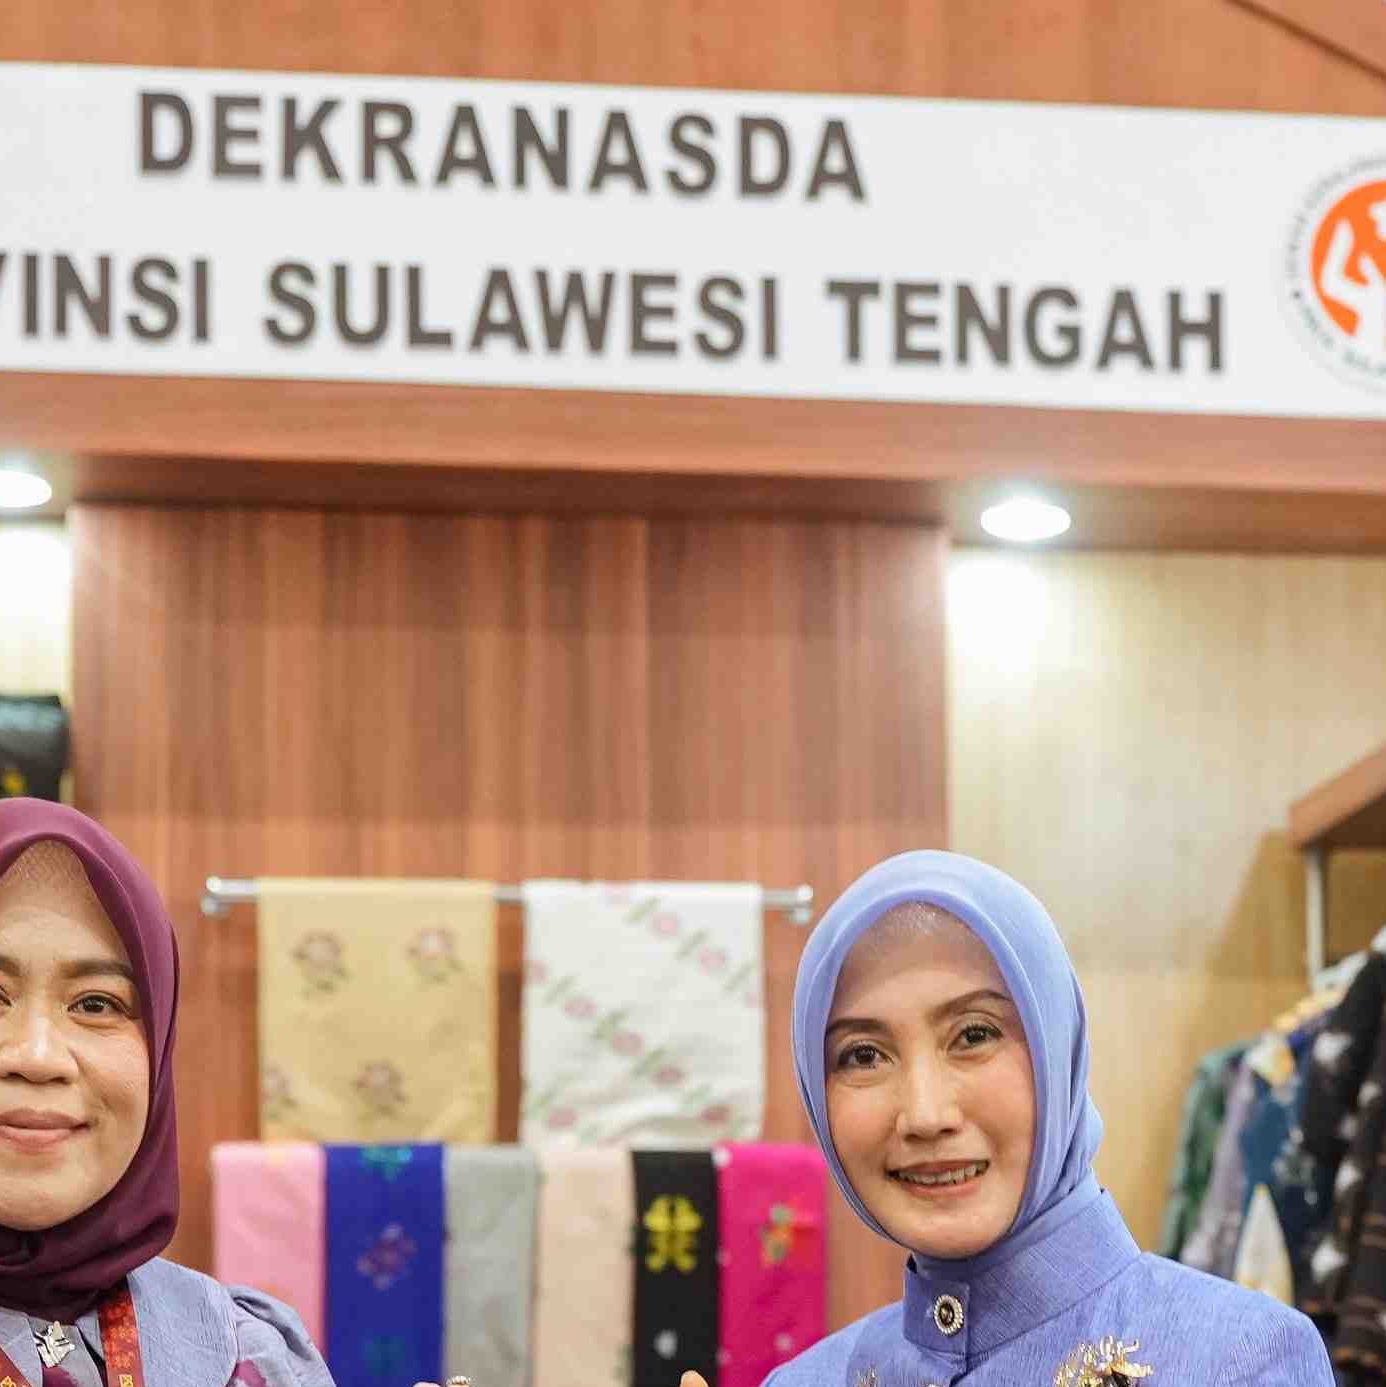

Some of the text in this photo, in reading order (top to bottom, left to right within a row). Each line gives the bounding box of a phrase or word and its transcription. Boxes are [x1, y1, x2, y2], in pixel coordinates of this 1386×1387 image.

[138, 89, 867, 203] DEKRANASDA
[262, 259, 779, 362] SULAWESI
[824, 277, 1224, 374] TENGAH
